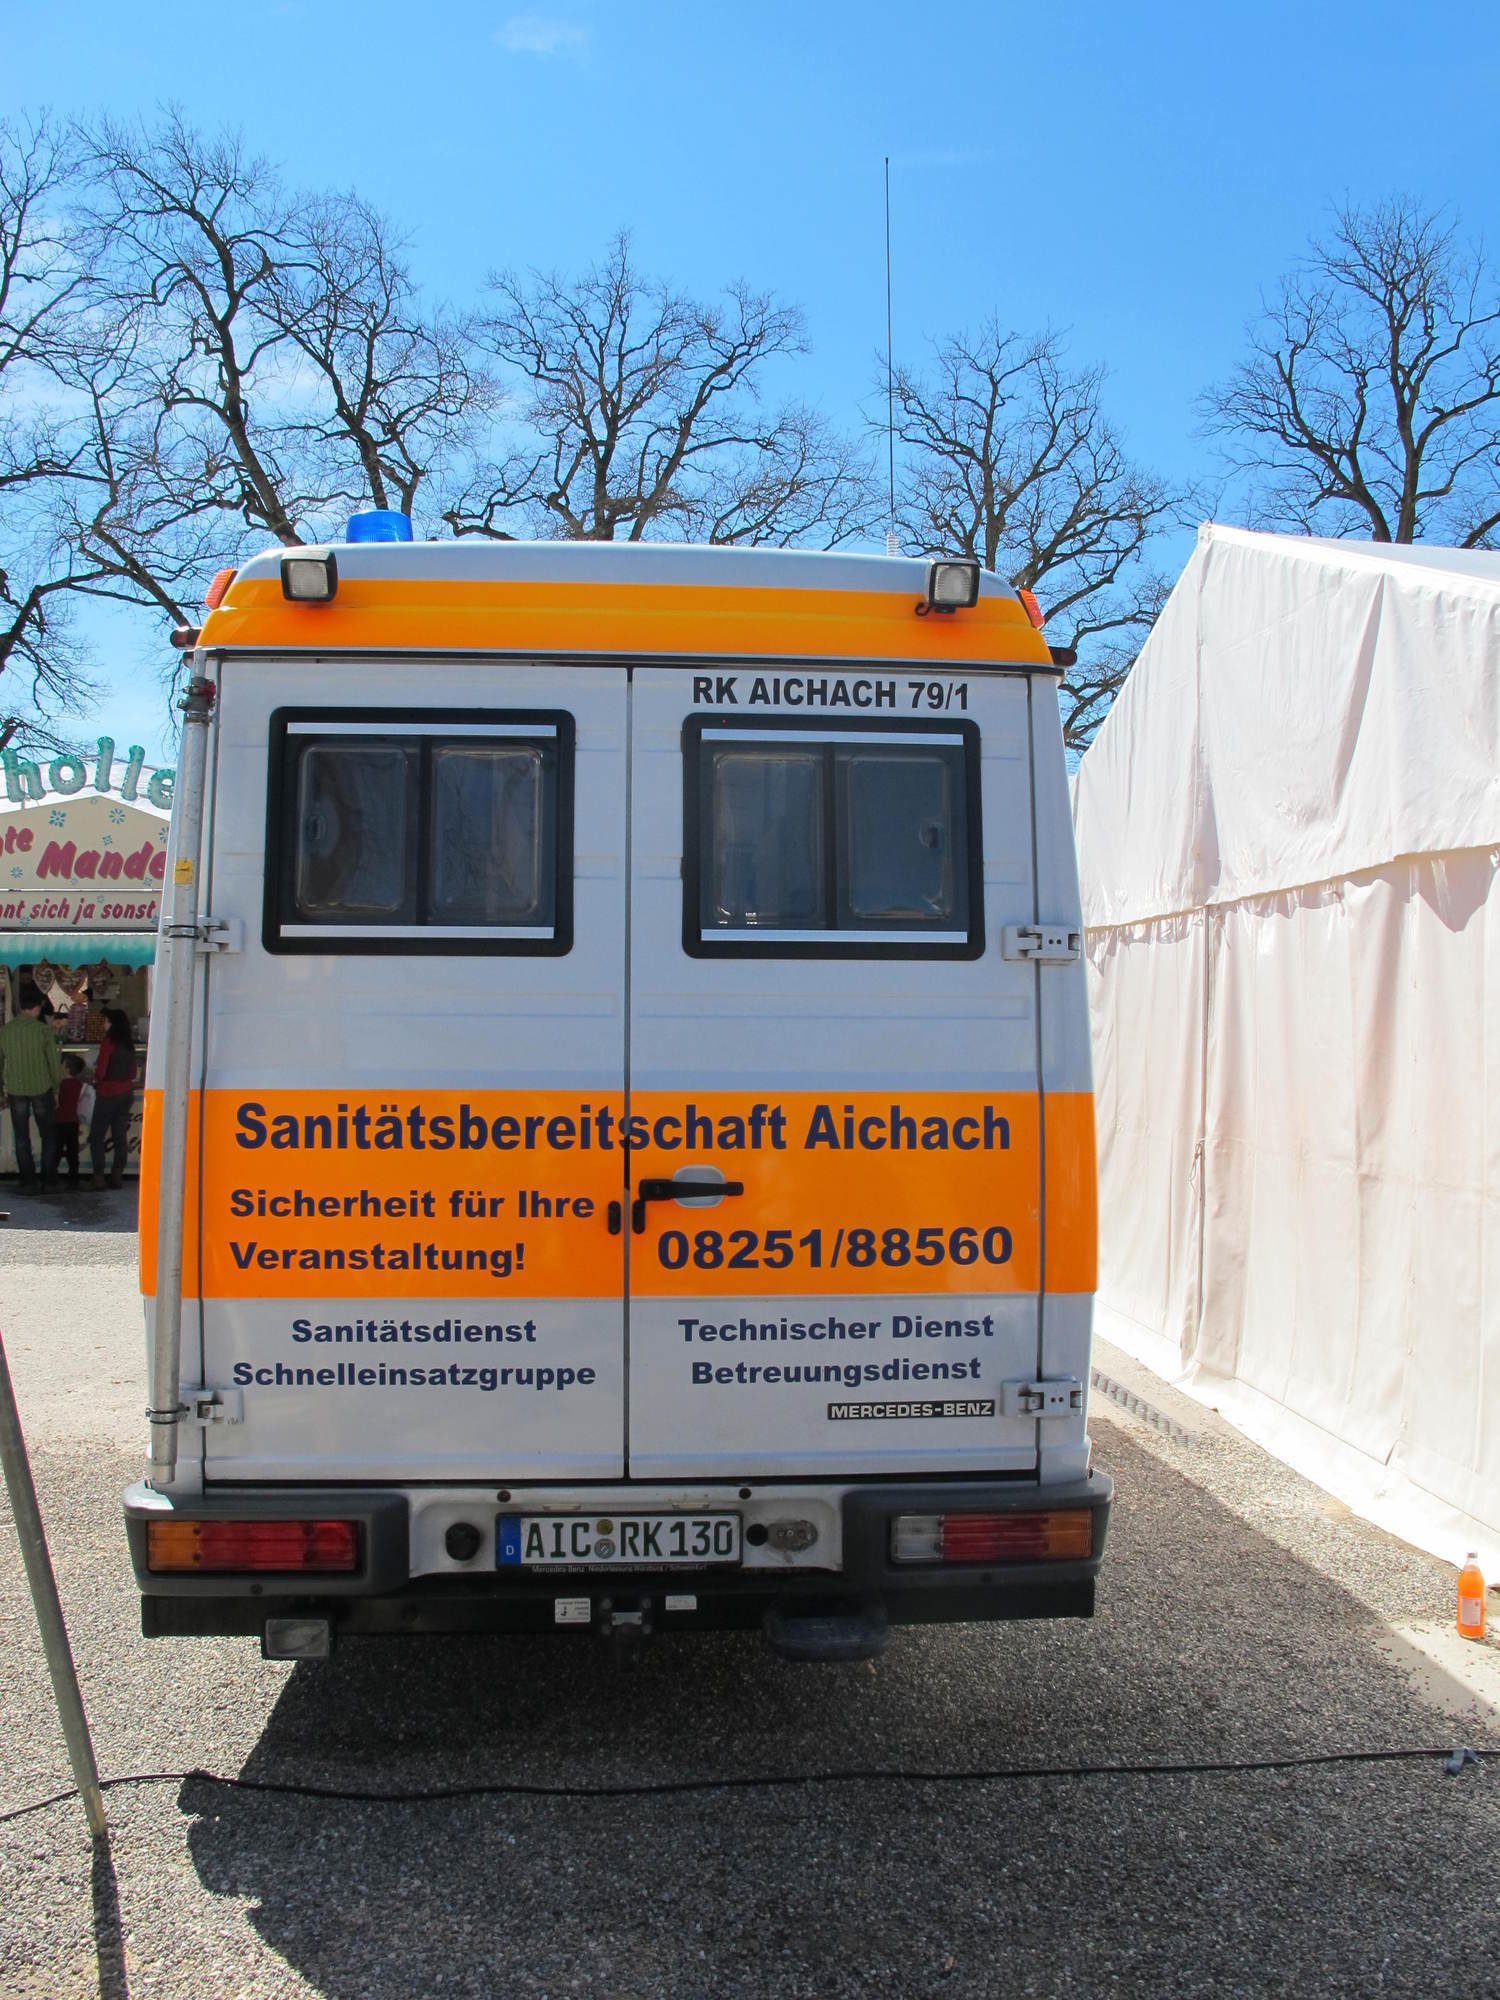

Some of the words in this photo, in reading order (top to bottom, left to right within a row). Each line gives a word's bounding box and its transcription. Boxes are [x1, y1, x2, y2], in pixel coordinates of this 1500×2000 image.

[693, 677, 738, 704] RK
[748, 678, 896, 708] AICHACH
[908, 681, 968, 710] 79/1
[0, 826, 34, 857] te
[29, 897, 70, 919] sich
[72, 897, 96, 925] ja
[101, 900, 156, 919] sonst
[235, 1102, 786, 1150] Sanitätsbereitschaft
[804, 1104, 1010, 1150] Aichach
[230, 1189, 436, 1218] Sicherheit
[450, 1190, 505, 1218] für
[518, 1190, 594, 1218] Ihre
[230, 1241, 525, 1278] Veranstaltung!
[657, 1226, 1013, 1270] 08251/88560
[292, 1319, 537, 1343] Sanitätsdienst
[678, 1316, 882, 1342] Technischer
[892, 1314, 994, 1339] Dienst
[233, 1362, 597, 1391] Schnelleinsatzgruppe
[691, 1357, 981, 1387] Betreuungsdienst
[830, 1401, 993, 1419] MERCEDES-BENZ
[505, 1544, 515, 1557] D
[525, 1522, 591, 1559] AIC
